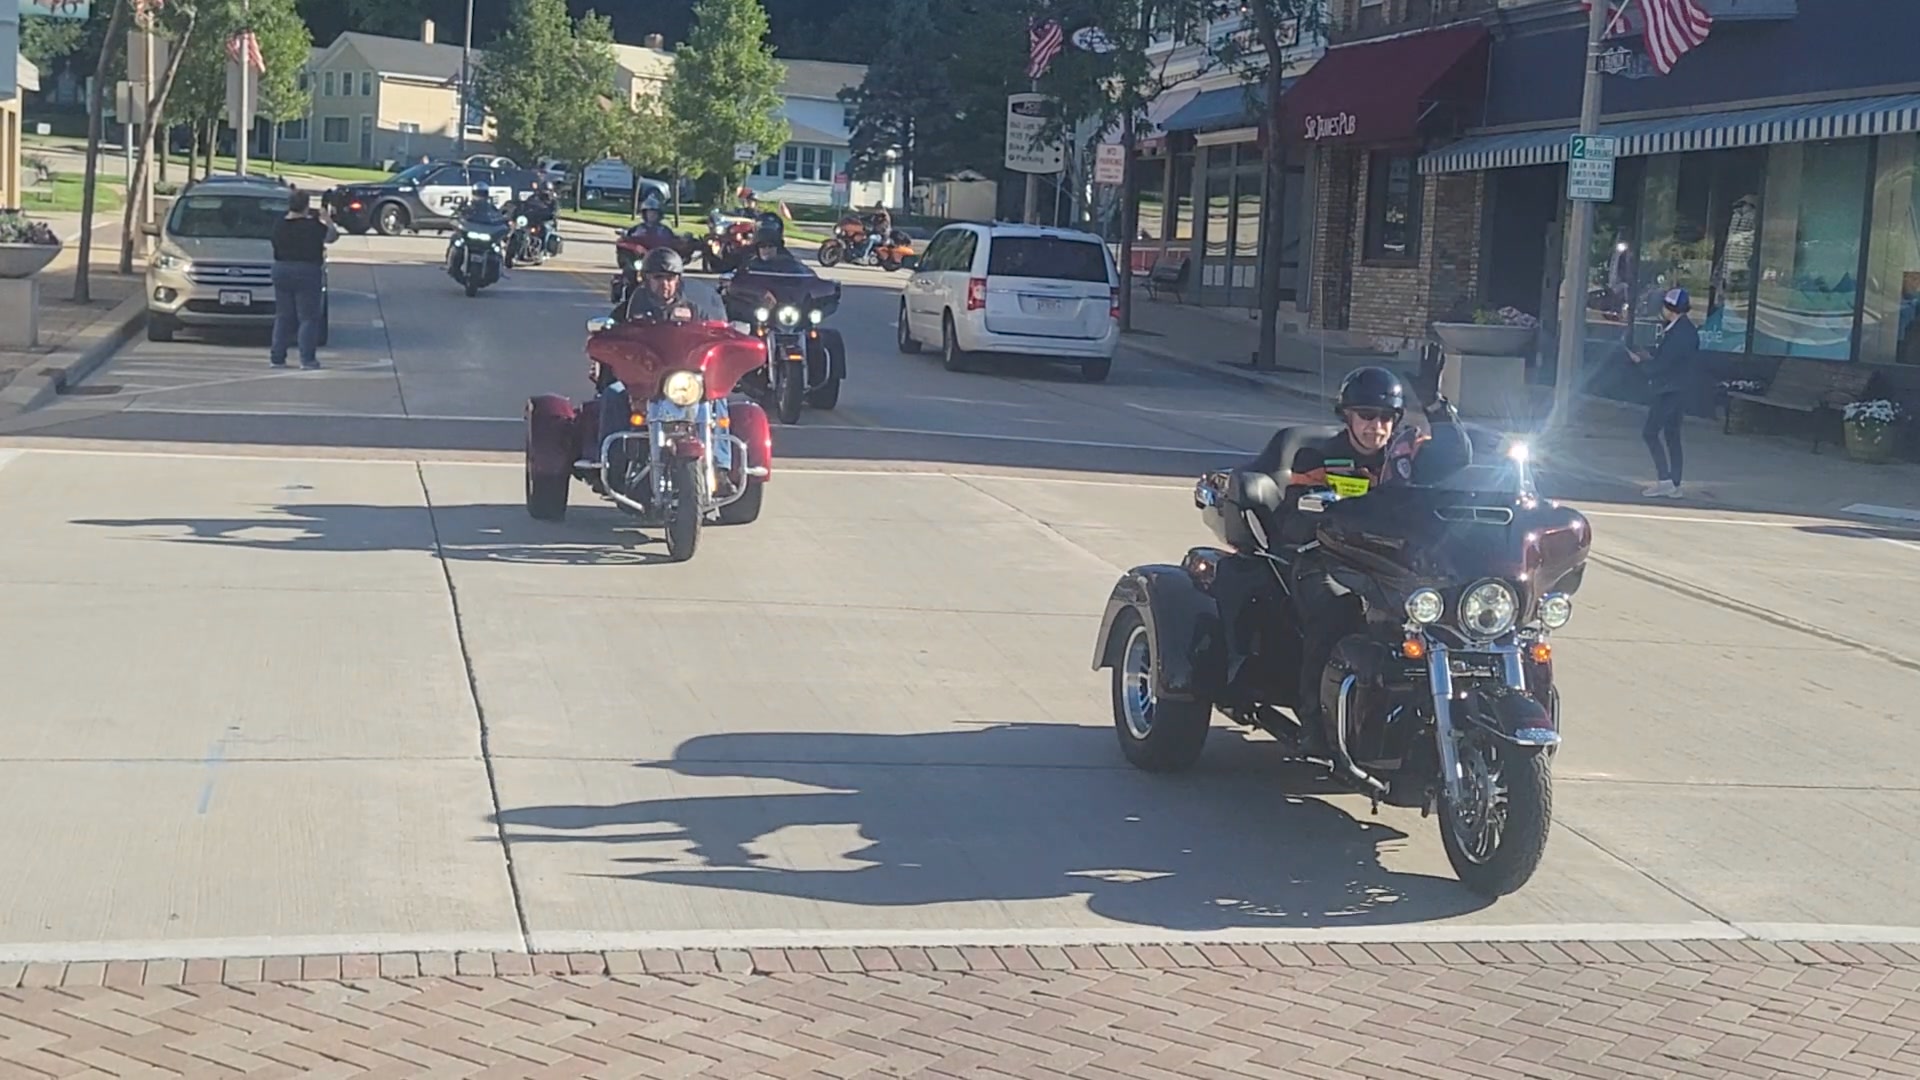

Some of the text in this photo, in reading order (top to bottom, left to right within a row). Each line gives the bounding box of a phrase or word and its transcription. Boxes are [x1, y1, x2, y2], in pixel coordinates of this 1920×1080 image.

[1107, 147, 1117, 156] NO
[1573, 138, 1584, 157] 2
[1586, 149, 1612, 158] PARKING
[1016, 154, 1044, 165] Parking
[1099, 158, 1122, 167] PARKING
